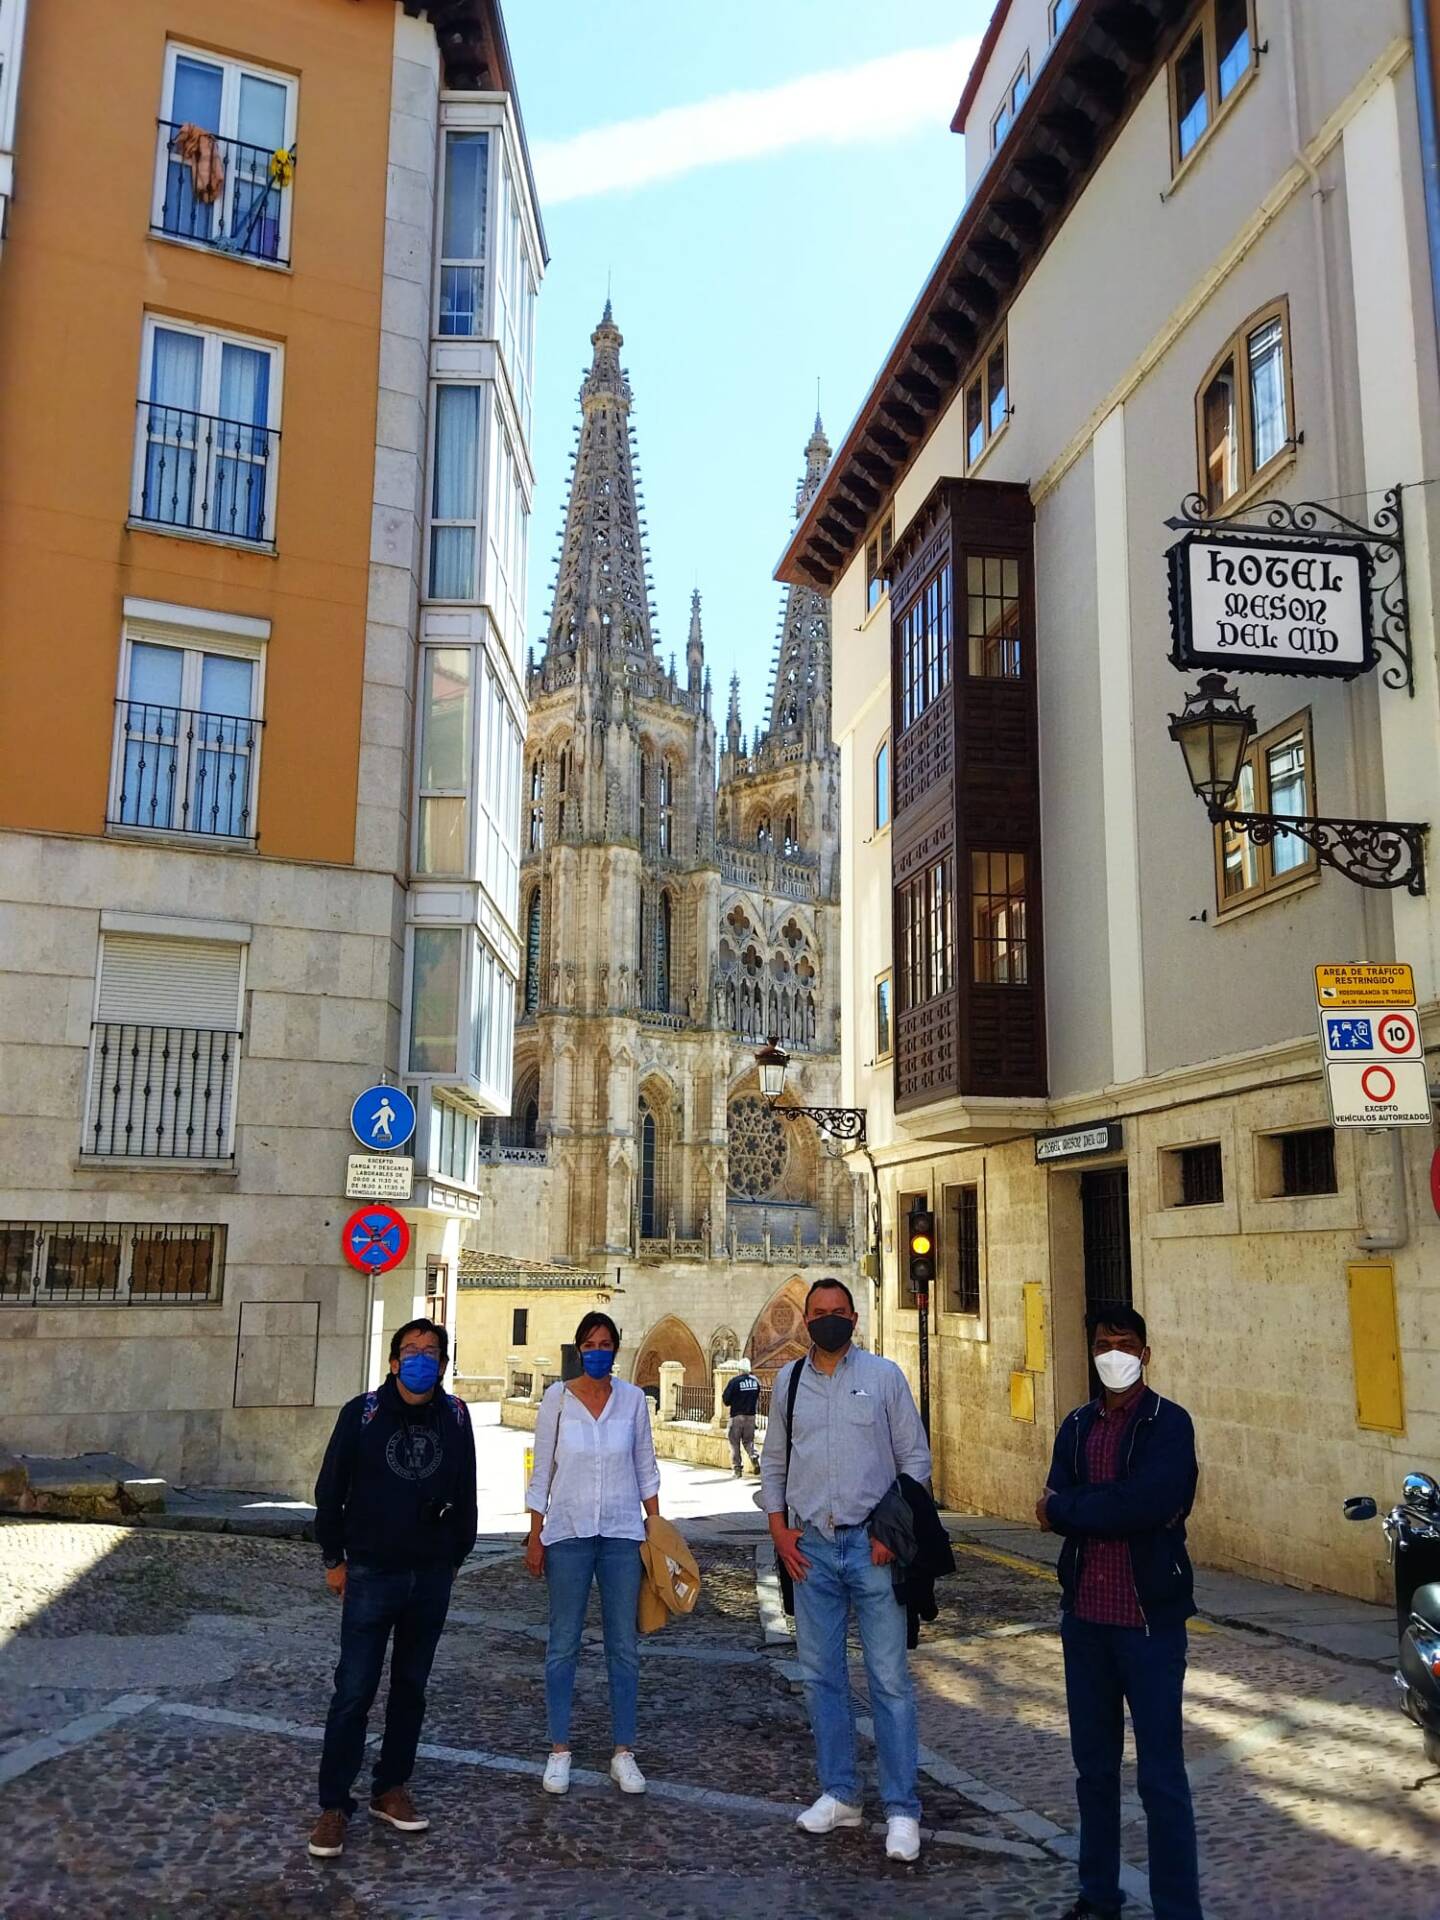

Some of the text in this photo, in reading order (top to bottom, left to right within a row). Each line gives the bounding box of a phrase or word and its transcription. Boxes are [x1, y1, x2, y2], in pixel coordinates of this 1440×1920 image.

[1206, 550, 1343, 593] HOTEL
[1224, 592, 1327, 625] MESON
[1216, 620, 1339, 655] DEL CID
[1335, 976, 1395, 984] RESTRINGIDO
[1351, 968, 1362, 976] DE
[1387, 1026, 1406, 1042] 10
[1335, 1113, 1430, 1122] VEHÍCULOS AUTORIZADOS
